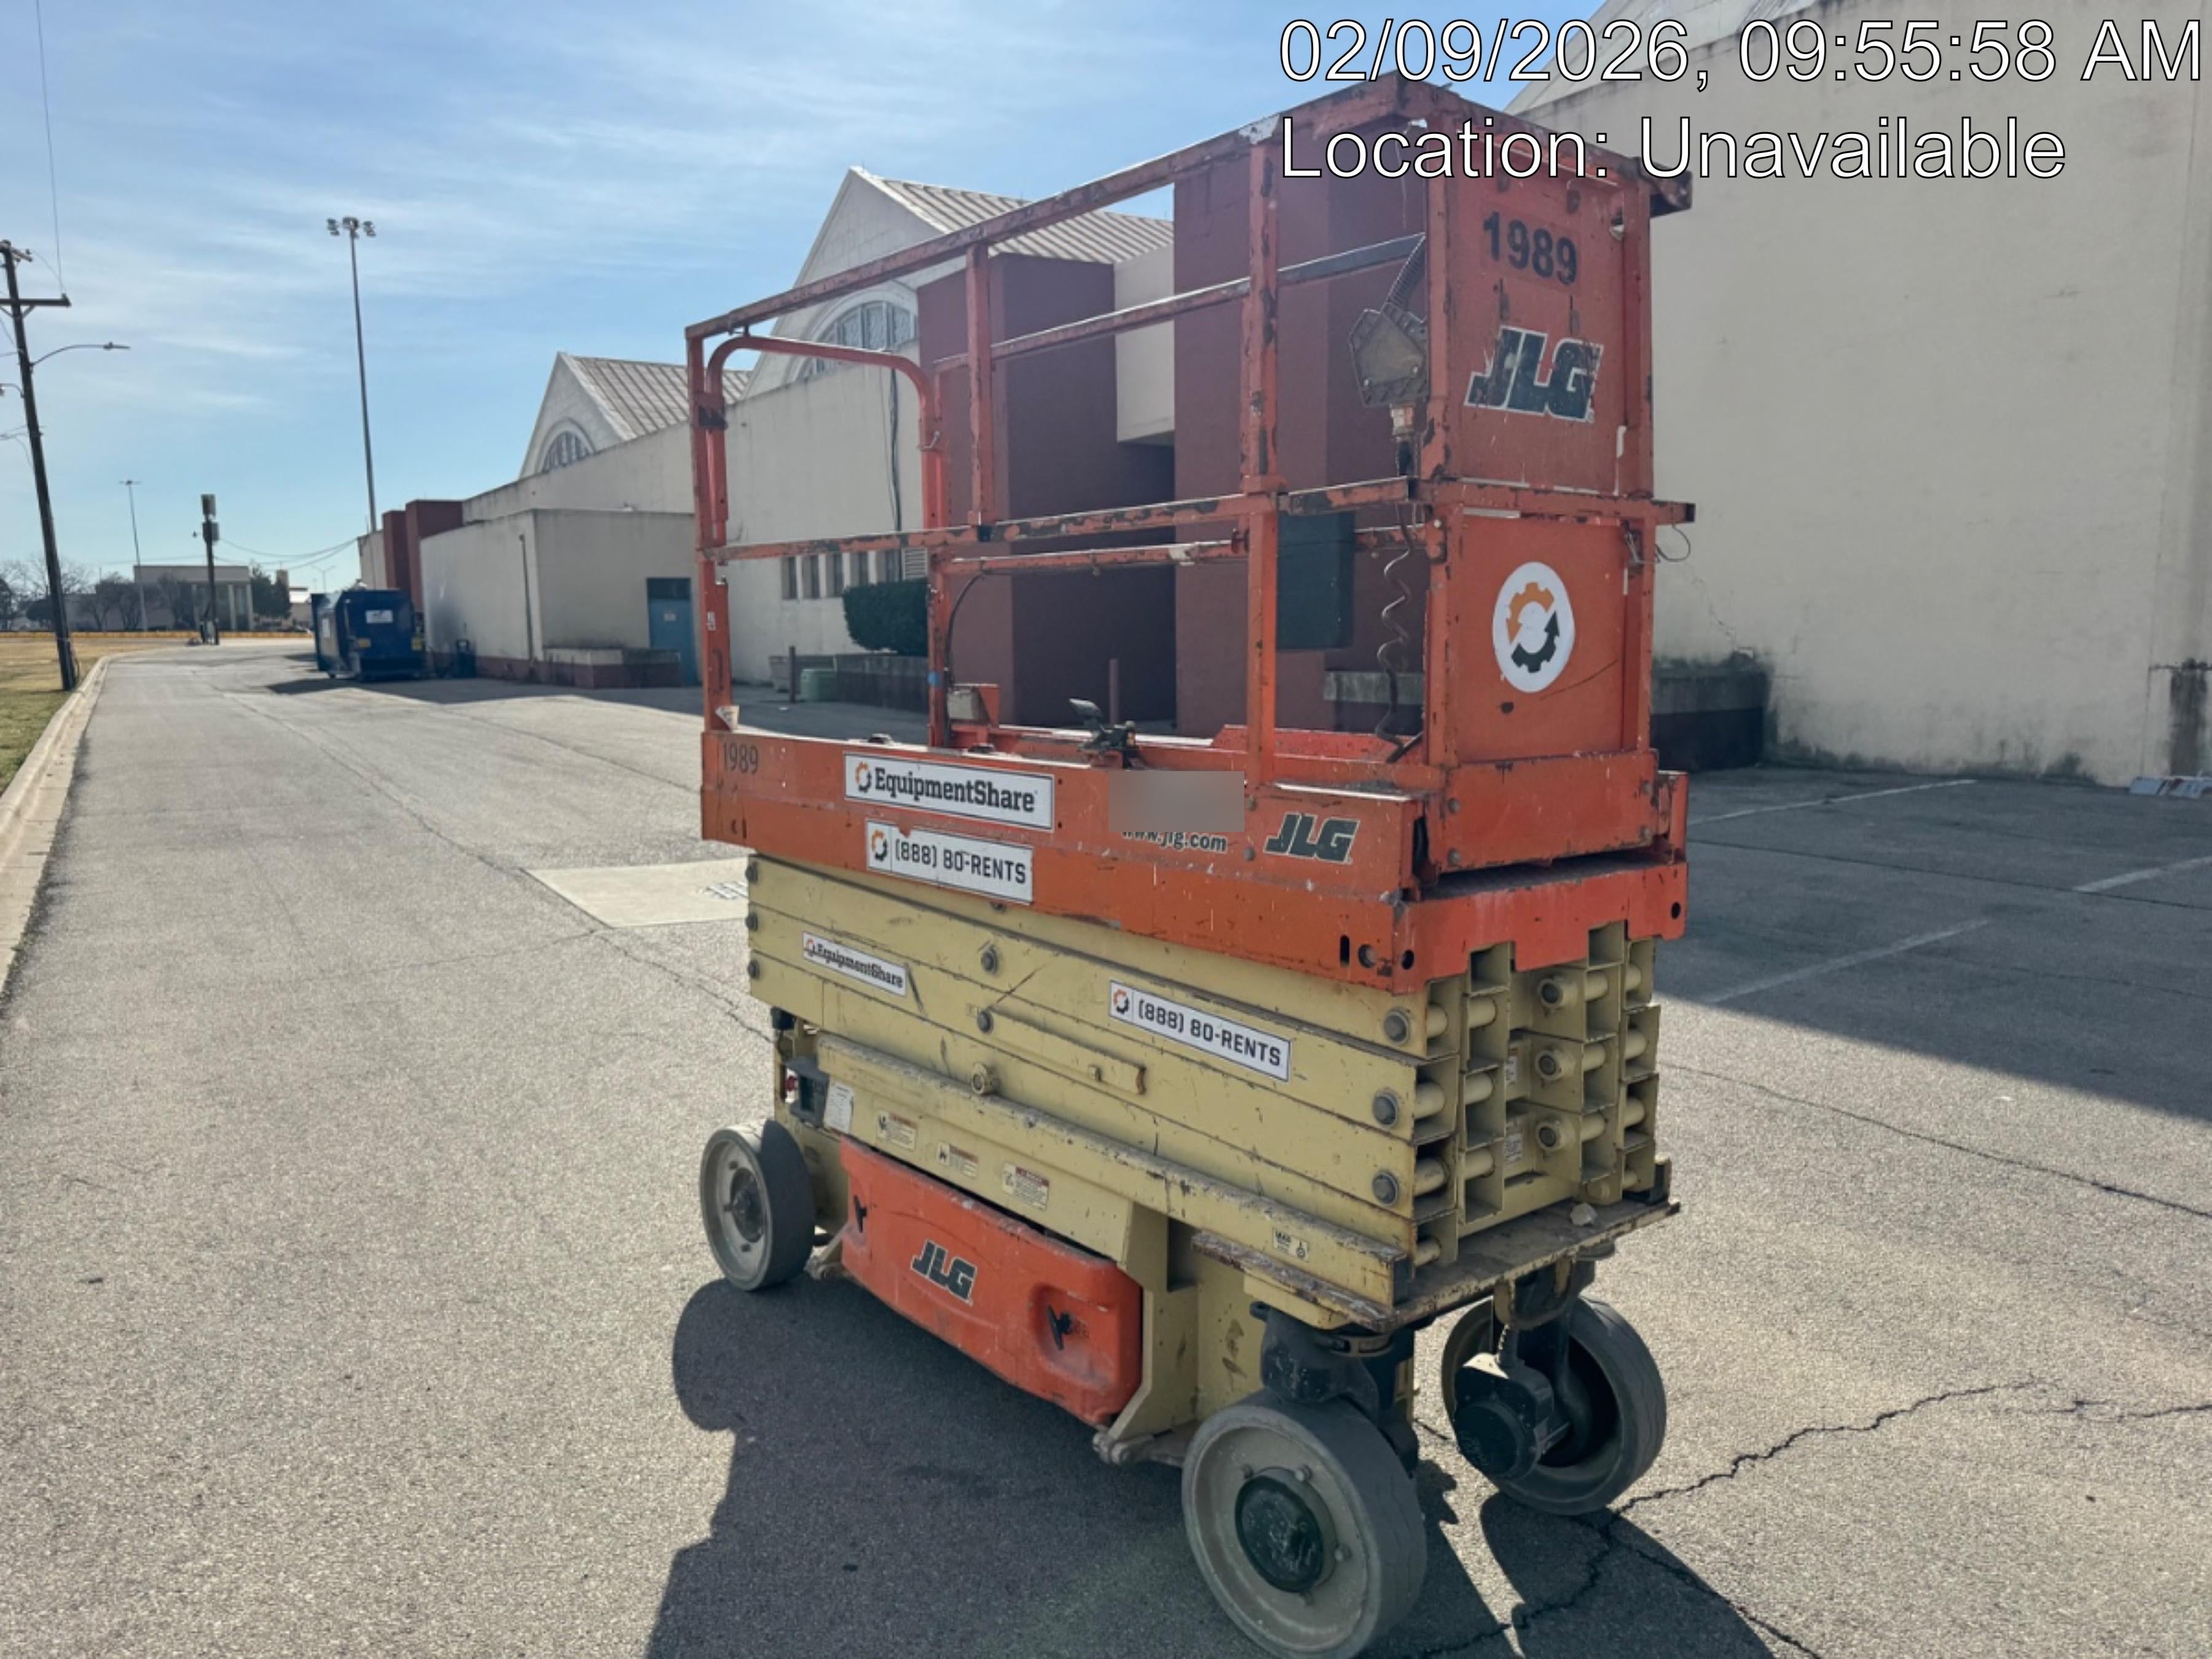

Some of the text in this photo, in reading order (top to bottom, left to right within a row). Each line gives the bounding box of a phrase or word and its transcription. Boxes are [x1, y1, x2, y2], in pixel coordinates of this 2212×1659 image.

[1483, 211, 1577, 286] 1989
[1464, 324, 1604, 423] JLG
[723, 742, 759, 775] 1989
[874, 767, 1035, 813] EquipmentShare
[895, 839, 1026, 884] (888) 80-RENTS
[1263, 812, 1360, 865] JLG
[817, 943, 903, 989] EquipmentShare
[1138, 998, 1281, 1067] (888) 80-RENTS
[910, 1239, 978, 1305] JLG
